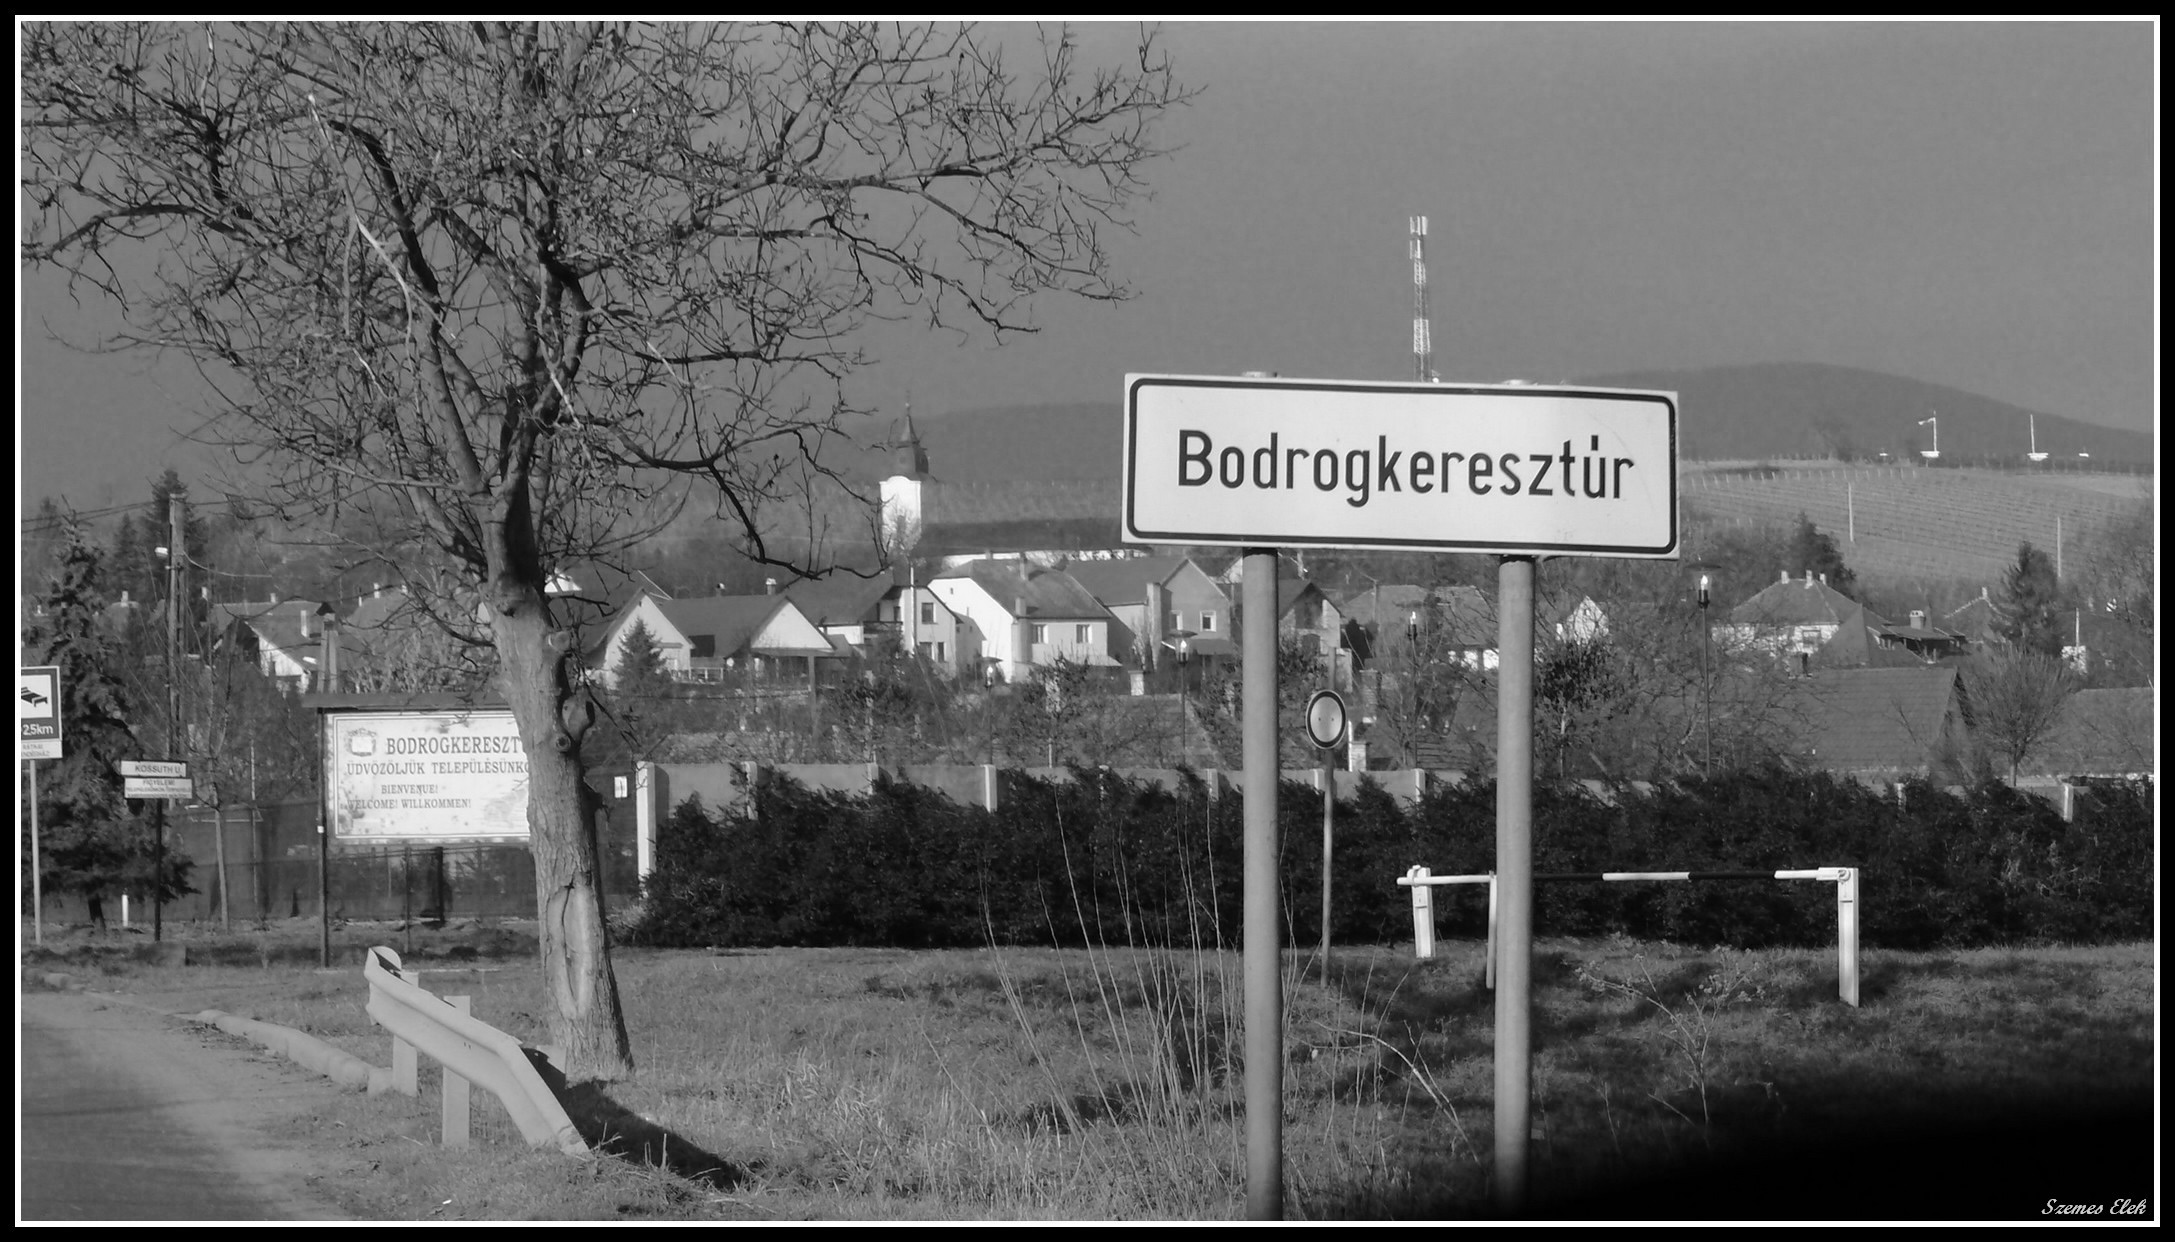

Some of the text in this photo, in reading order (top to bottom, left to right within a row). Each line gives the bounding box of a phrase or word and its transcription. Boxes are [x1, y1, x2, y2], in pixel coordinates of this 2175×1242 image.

[1178, 429, 1634, 507] Bodrogkeresztúr
[386, 735, 522, 755] BODROGKERESZT
[135, 764, 173, 774] KOSSUTH
[347, 759, 425, 776] ÜDVÖZÖLJÜK
[381, 784, 438, 795] BIENVENUE!
[401, 798, 471, 809] WILLKOMMEN!
